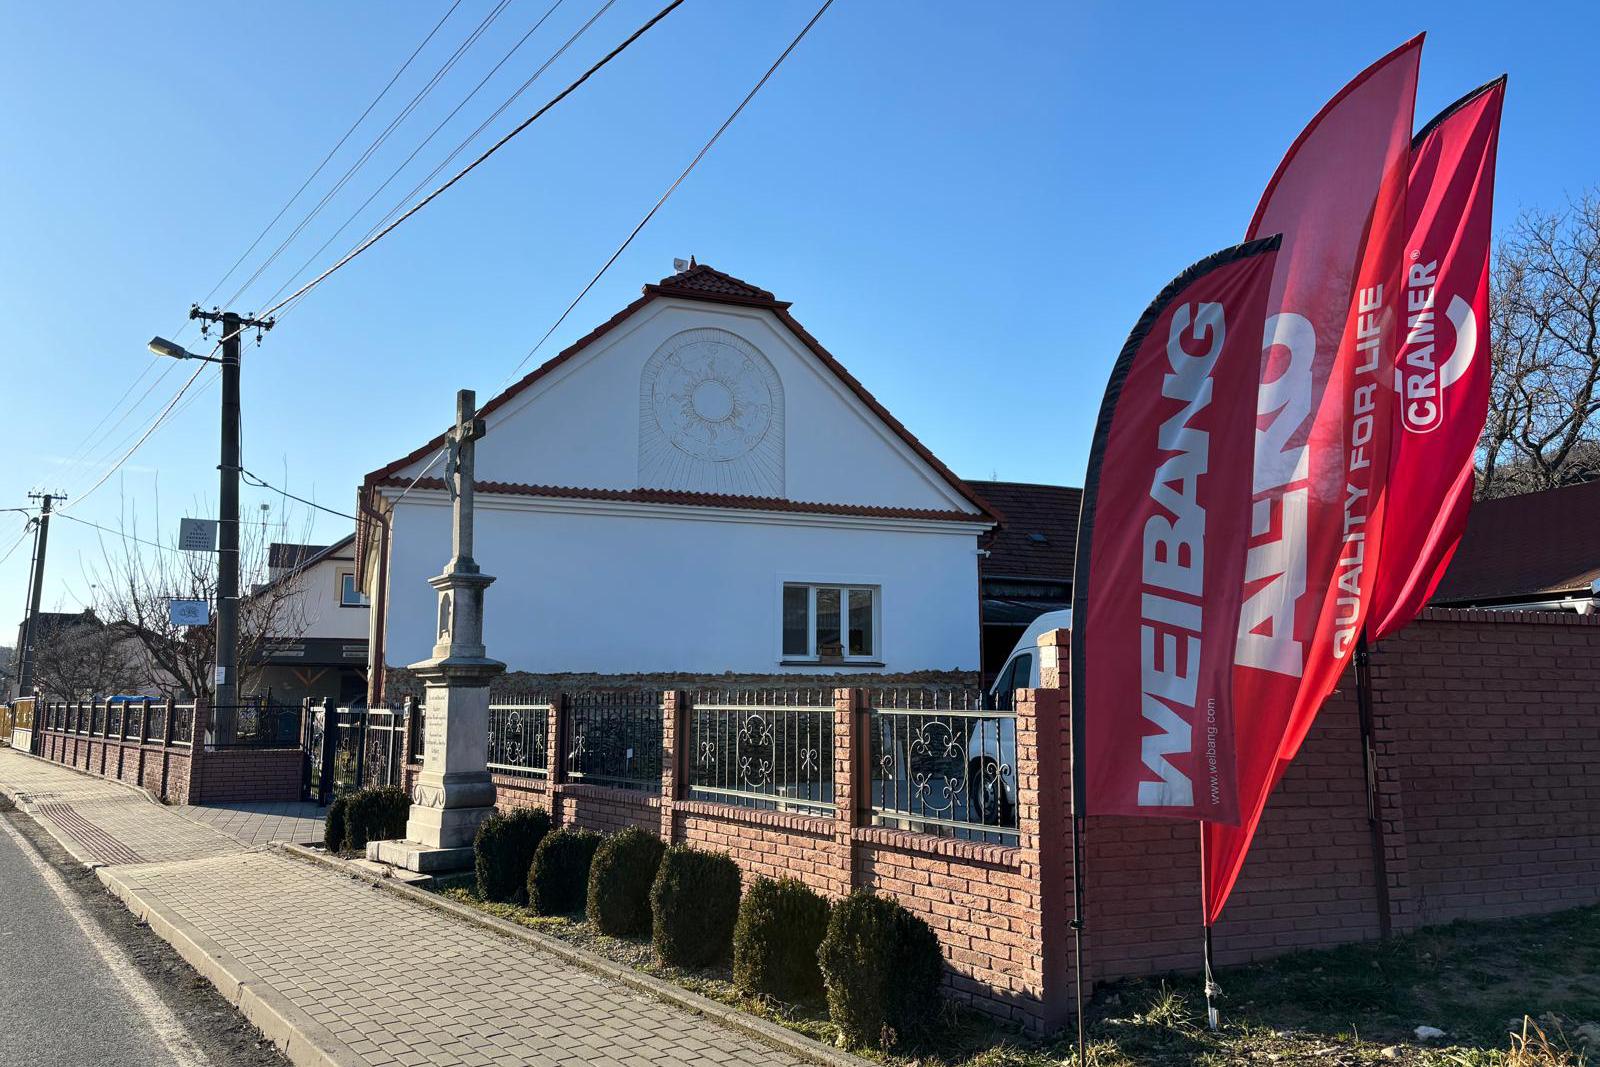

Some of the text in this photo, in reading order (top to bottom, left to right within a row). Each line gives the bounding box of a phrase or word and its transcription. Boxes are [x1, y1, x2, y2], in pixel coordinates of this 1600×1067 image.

[1138, 302, 1226, 807] WEIBANG
[1333, 284, 1383, 660] QUALITY FOR LIFE
[1206, 698, 1219, 805] www.weibang.com
